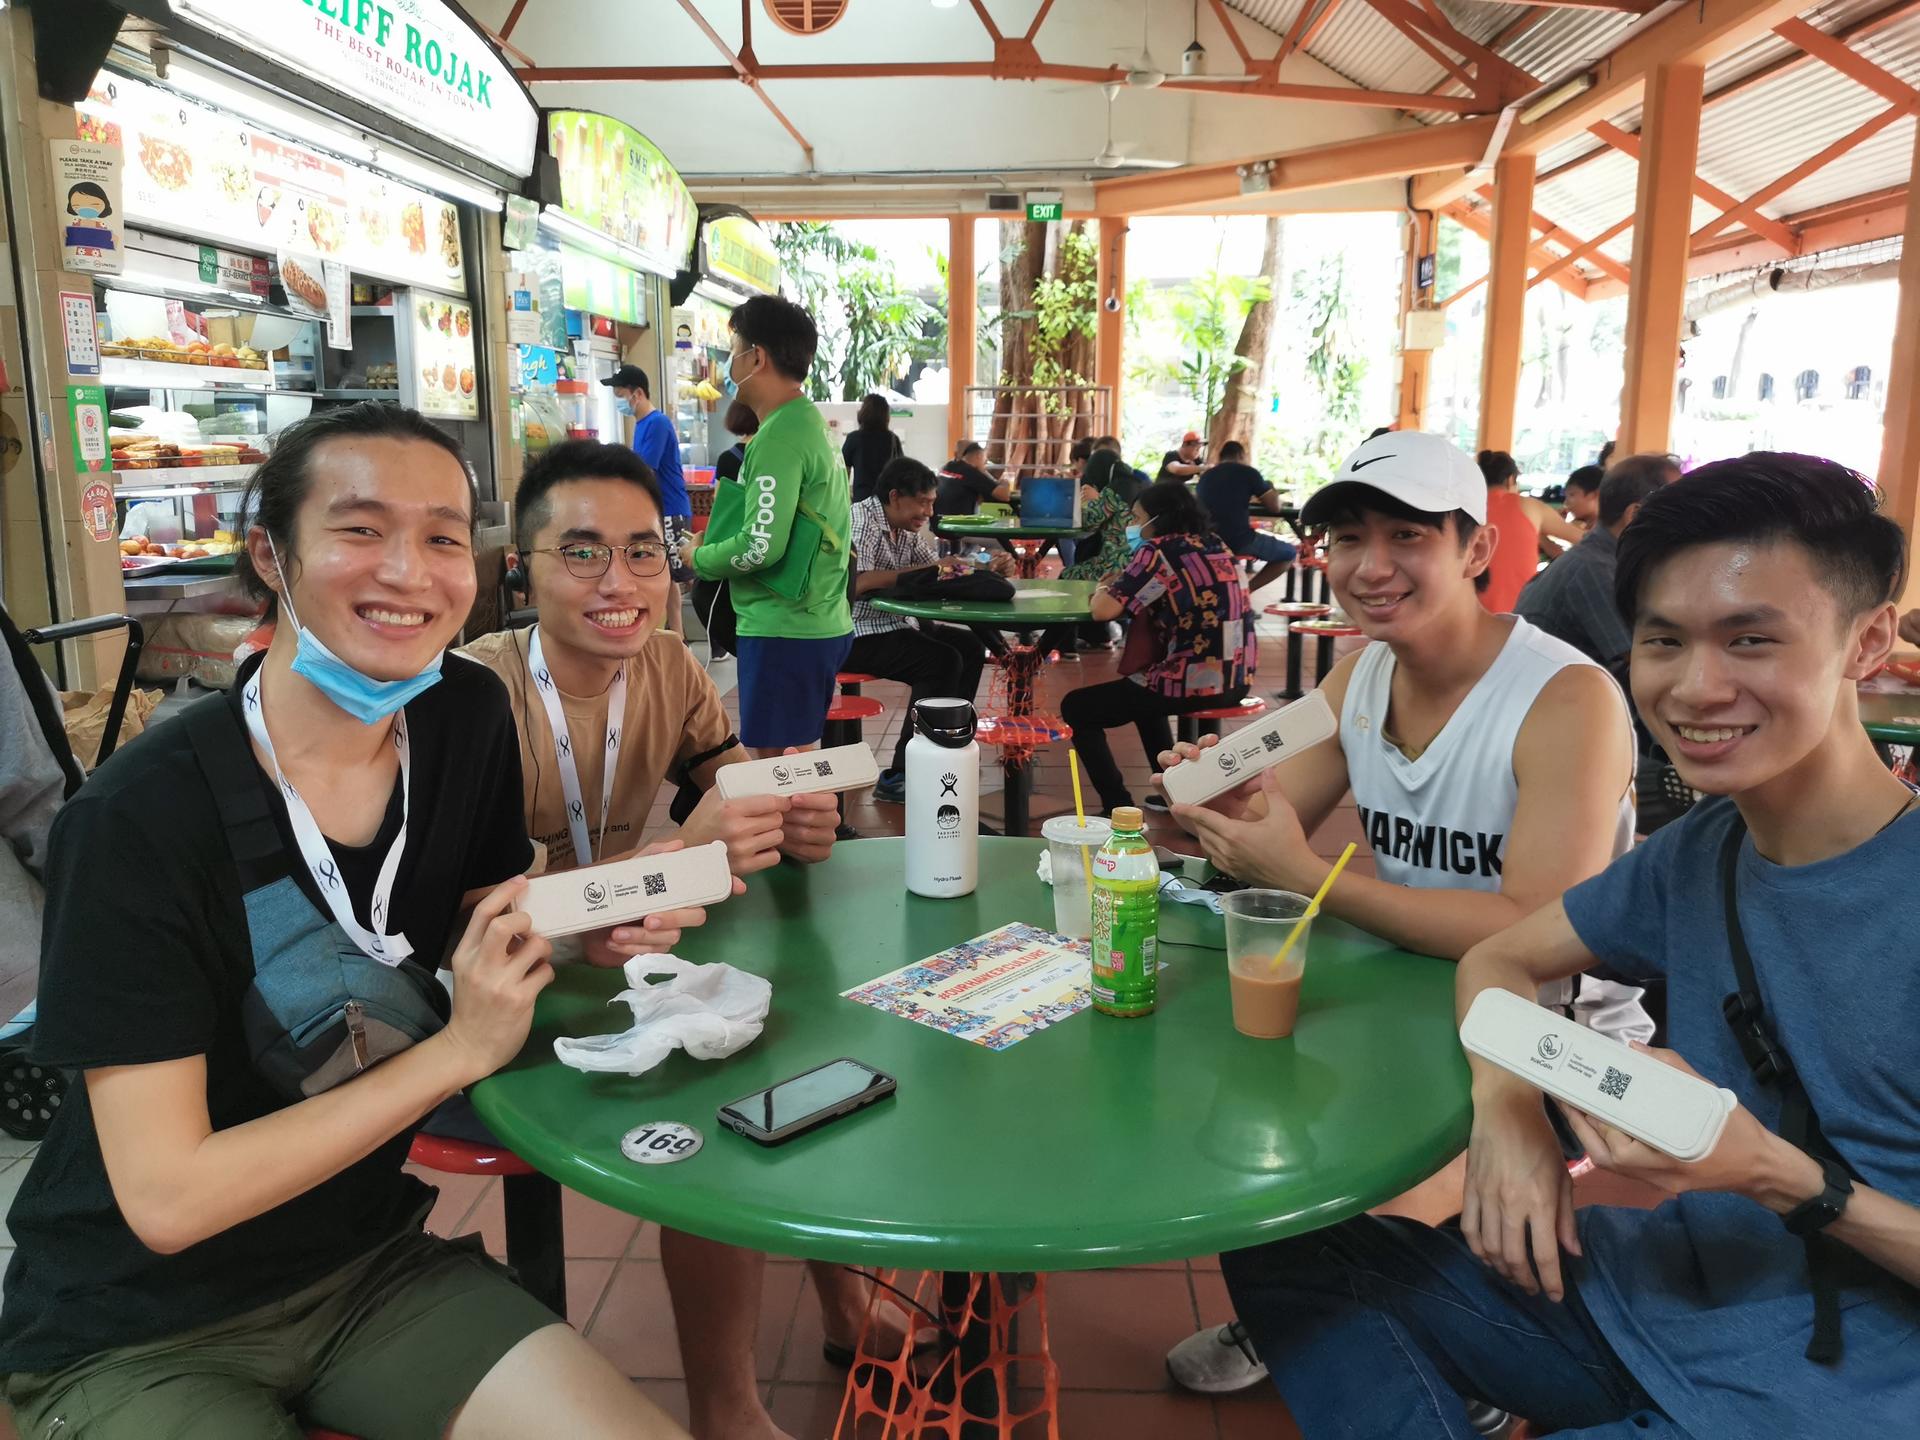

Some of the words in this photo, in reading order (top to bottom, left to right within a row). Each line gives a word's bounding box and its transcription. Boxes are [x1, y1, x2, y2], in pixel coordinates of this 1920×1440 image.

[303, 0, 394, 47] LIFF
[404, 23, 492, 109] ROJAK
[314, 16, 343, 44] THE
[348, 35, 382, 64] BEST
[386, 56, 427, 88] ROJAK
[1032, 204, 1056, 219] EXIT
[730, 475, 776, 571] GrabFood
[634, 1128, 696, 1155] 169
